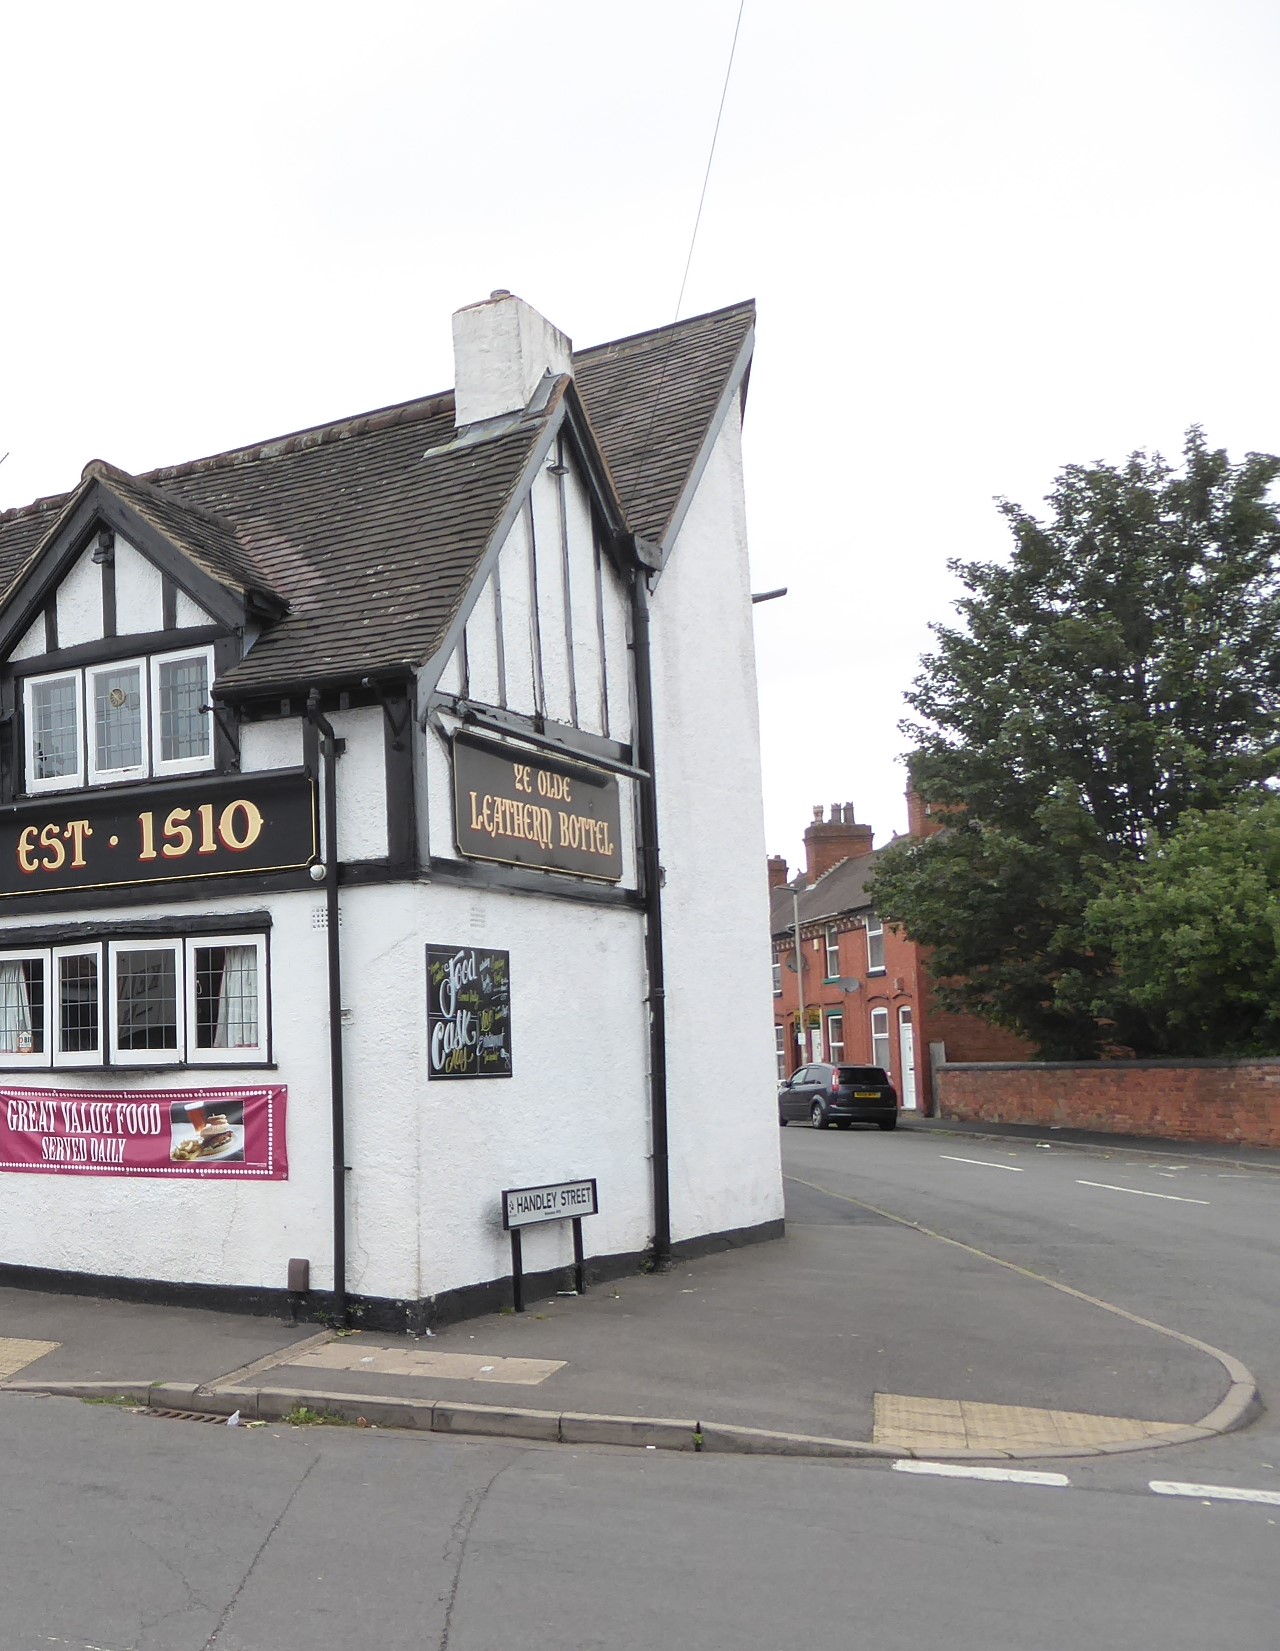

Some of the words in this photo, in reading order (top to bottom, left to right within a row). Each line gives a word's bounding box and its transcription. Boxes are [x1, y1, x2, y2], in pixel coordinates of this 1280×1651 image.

[513, 763, 532, 793] YE
[537, 769, 572, 803] OLDE
[469, 791, 553, 850] LEATHERN
[558, 811, 614, 856] BOTTEL
[17, 819, 94, 874] EST
[440, 949, 478, 1019] Food
[7, 1099, 57, 1133] GREAT
[60, 1101, 114, 1134] VALUE
[116, 1102, 162, 1135] FOOD
[41, 1136, 88, 1161] SERVED
[90, 1137, 127, 1163] DAILY
[516, 1192, 558, 1214] HANDLEY
[560, 1186, 591, 1207] STREET
